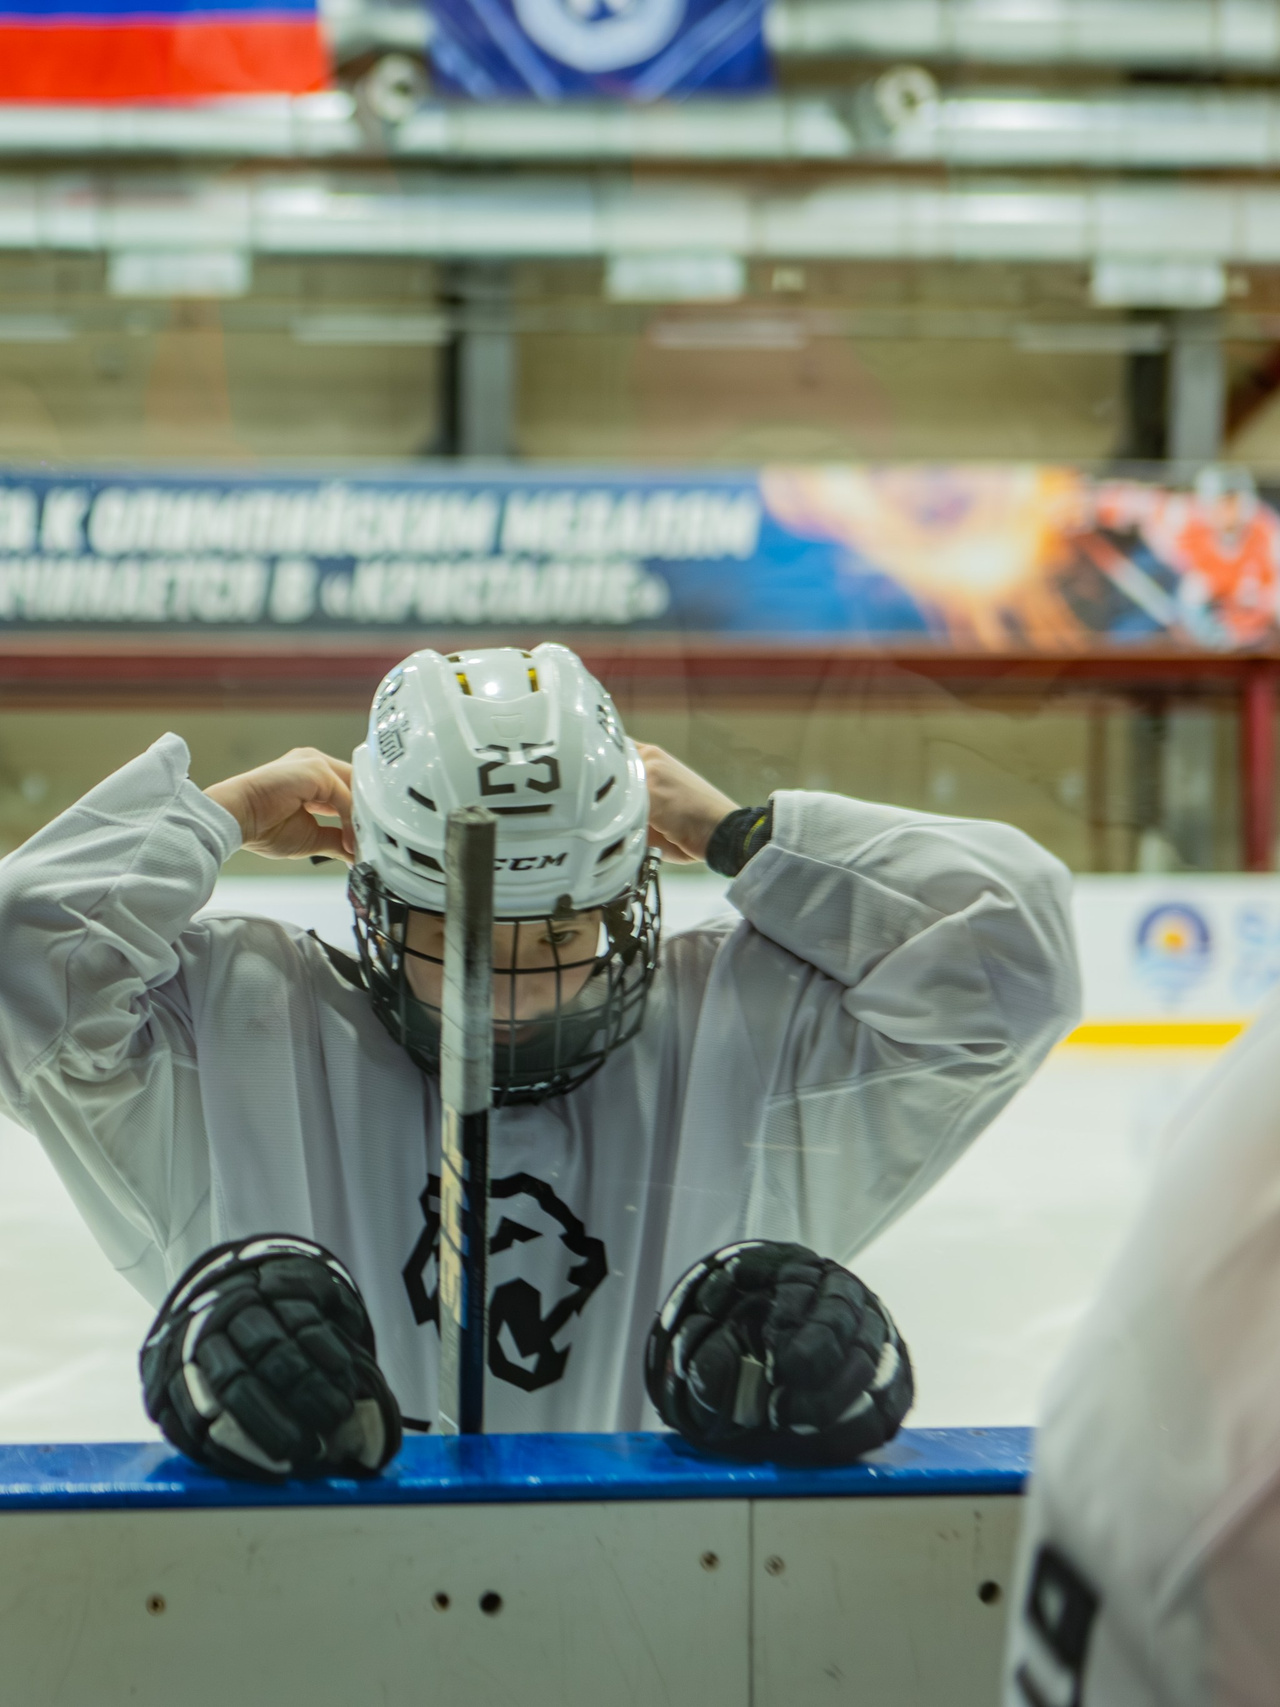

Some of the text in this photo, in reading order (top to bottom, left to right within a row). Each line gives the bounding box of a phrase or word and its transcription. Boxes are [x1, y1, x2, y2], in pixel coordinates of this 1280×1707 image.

[42, 487, 88, 554] К
[89, 483, 499, 556] ОЛИМПИЙСКИМ
[501, 488, 760, 559] МЕДАЛЯМ
[271, 556, 318, 622] В
[475, 740, 561, 796] 25
